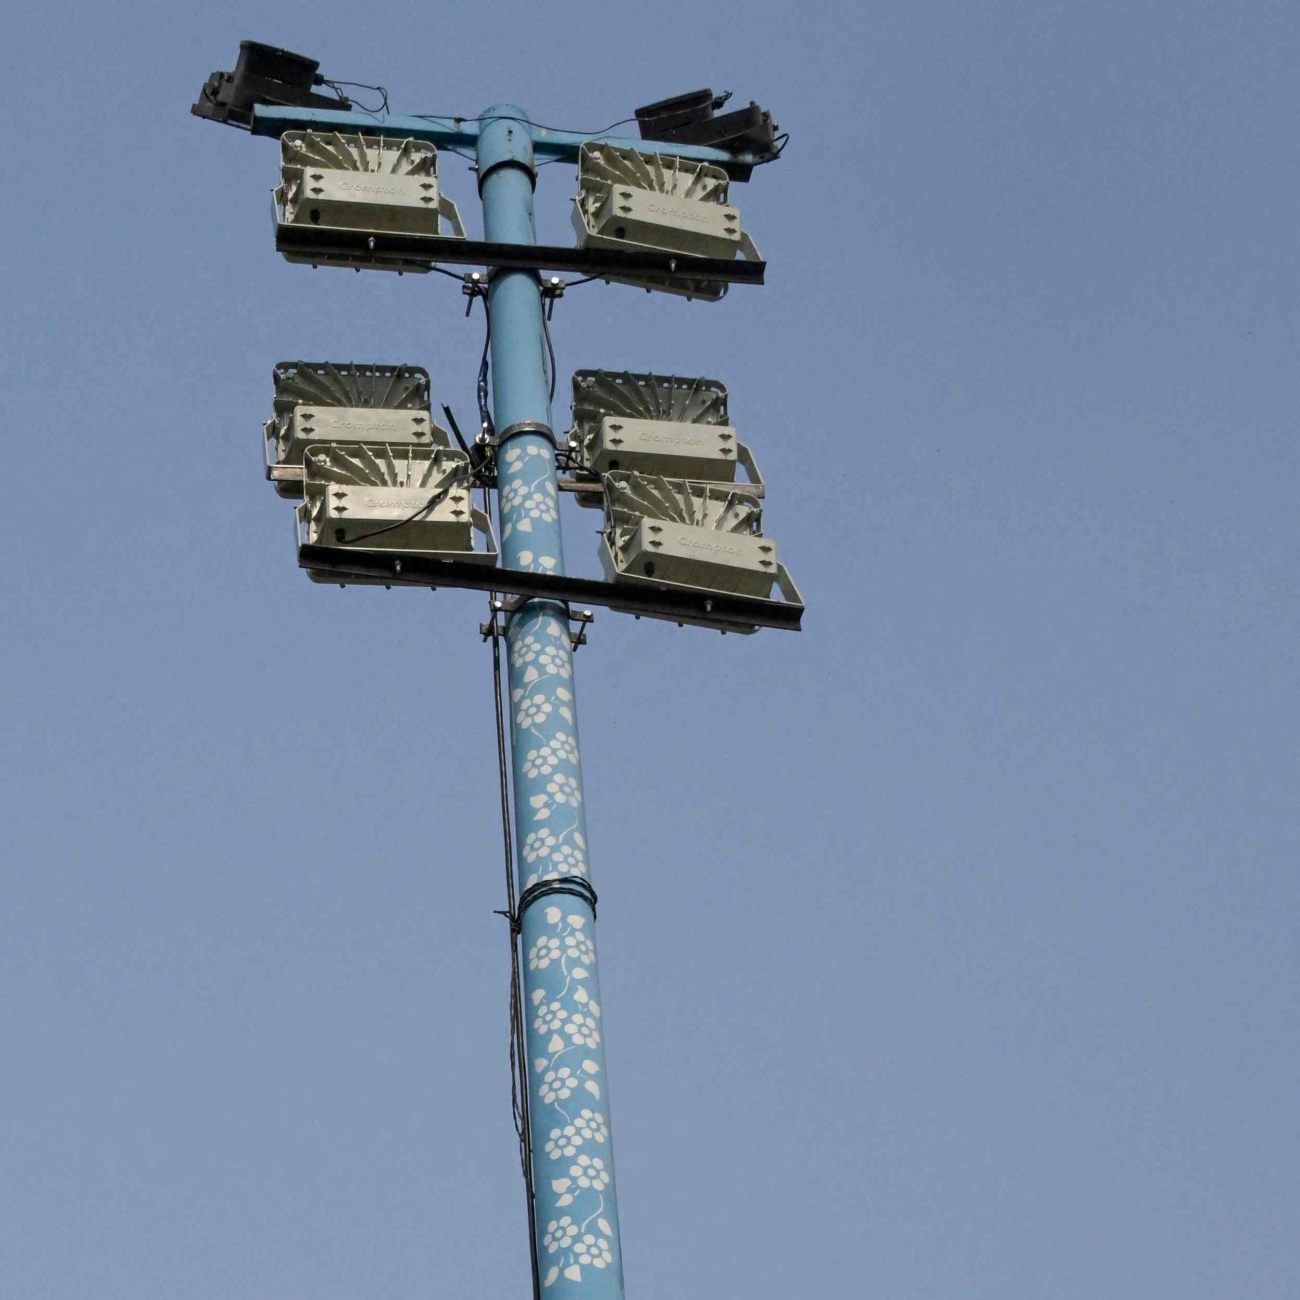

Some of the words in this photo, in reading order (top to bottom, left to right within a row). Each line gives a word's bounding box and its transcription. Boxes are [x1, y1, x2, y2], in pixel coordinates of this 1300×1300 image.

[339, 182, 405, 197] Crompton
[330, 420, 397, 433] Crompton
[363, 498, 425, 512] Crompto
